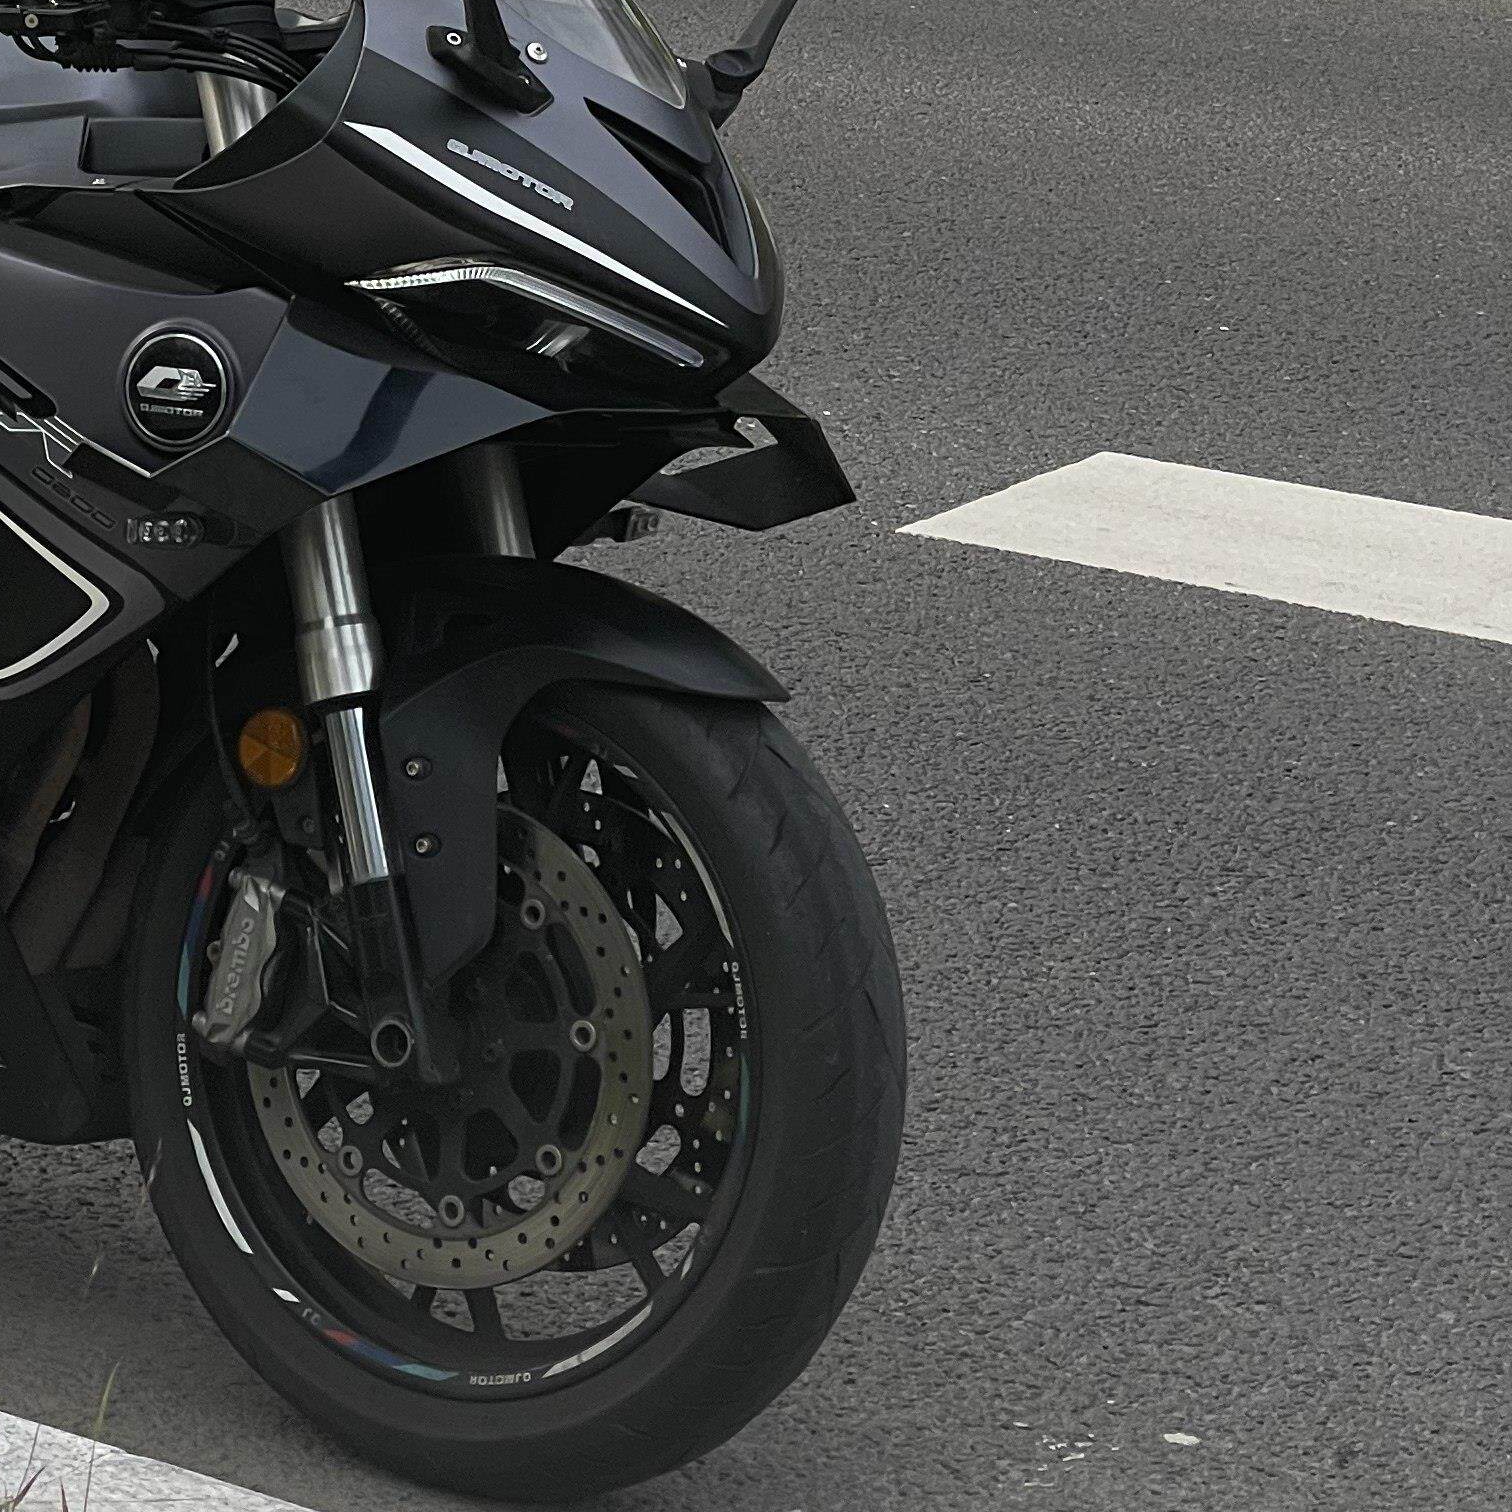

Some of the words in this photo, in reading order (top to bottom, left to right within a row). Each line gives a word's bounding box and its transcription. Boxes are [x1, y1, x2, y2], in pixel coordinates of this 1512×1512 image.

[215, 917, 255, 1015] brembo
[176, 1033, 193, 1106] QJMOTOR
[469, 1371, 532, 1386] QJMOTOR
